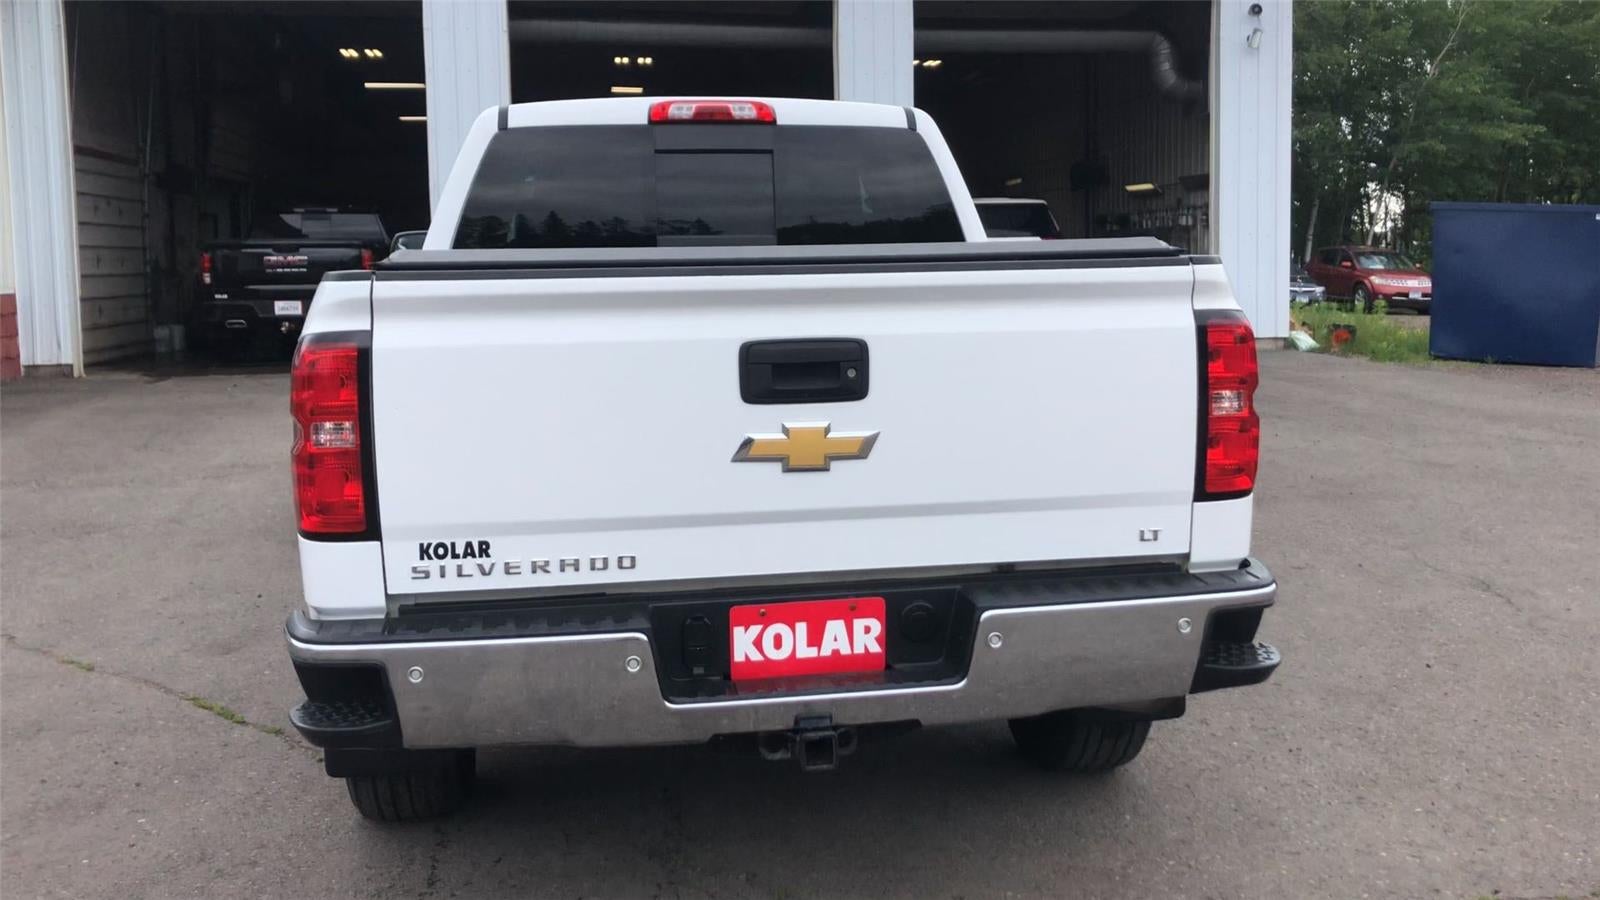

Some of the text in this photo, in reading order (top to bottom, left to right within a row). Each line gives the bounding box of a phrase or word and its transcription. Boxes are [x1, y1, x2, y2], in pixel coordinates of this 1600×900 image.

[1139, 527, 1162, 542] LT
[418, 540, 491, 561] KOLAR
[410, 554, 637, 580] SILVERADO
[732, 617, 882, 663] KOLAR
